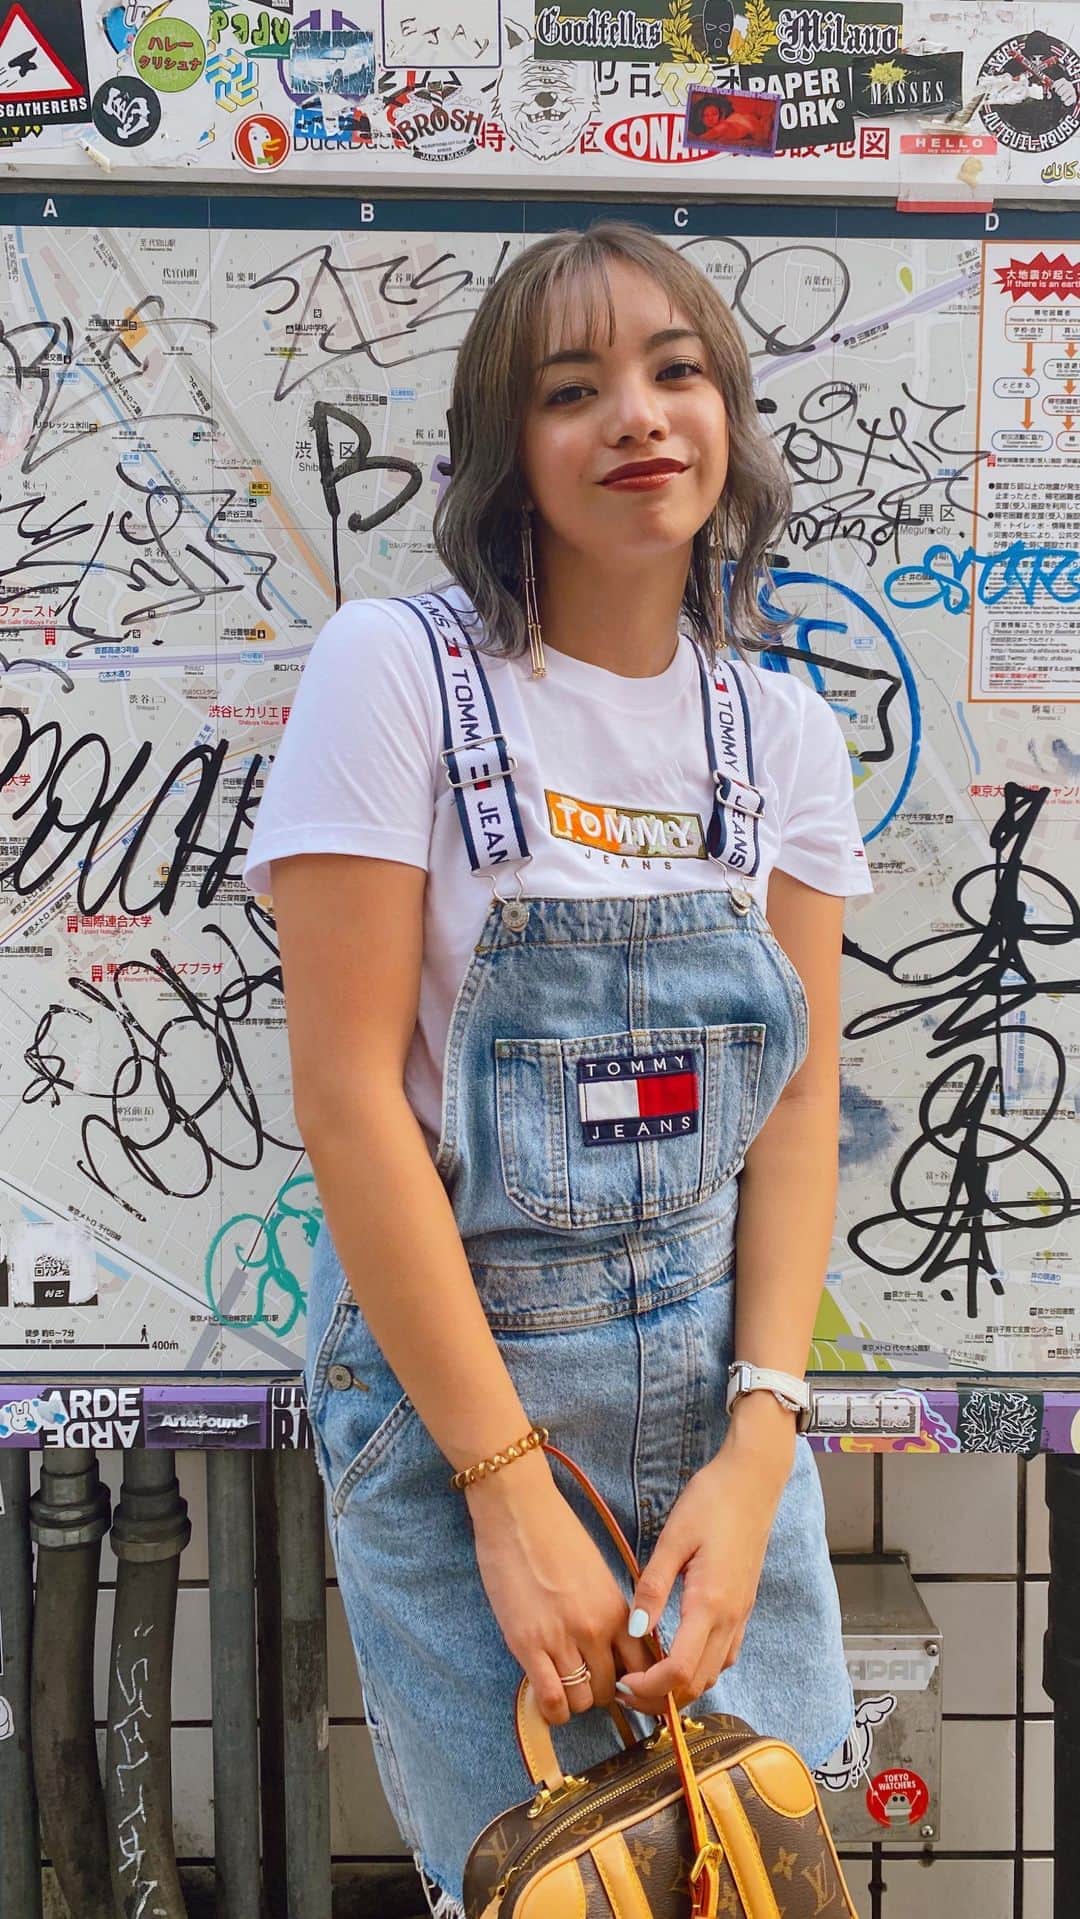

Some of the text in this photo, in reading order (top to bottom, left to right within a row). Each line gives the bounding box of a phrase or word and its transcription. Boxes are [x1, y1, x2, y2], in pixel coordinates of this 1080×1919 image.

[535, 6, 899, 64] Goodfellas Milano
[749, 68, 840, 99] PAPER
[871, 80, 944, 105] MASSES
[396, 104, 485, 144] BROSH
[915, 137, 983, 149] HELLO
[42, 198, 58, 218] A
[361, 203, 375, 223] B
[674, 207, 689, 228] C
[985, 213, 999, 231] D
[1015, 280, 1037, 288] there
[1039, 280, 1046, 288] is
[295, 441, 356, 460] 渋区
[208, 705, 279, 719] 渋谷ヒカリエ
[452, 668, 486, 753] TOMMY
[716, 699, 741, 773] TOMMY
[476, 801, 511, 866] JEAN
[556, 801, 692, 849] TOMMY
[727, 794, 748, 870] JEANS
[584, 850, 672, 871] JEANS
[81, 914, 153, 928] 国際連合大学
[586, 1055, 685, 1077] TOMMY
[592, 1116, 691, 1140] JEANS
[152, 1340, 179, 1350] 400m
[878, 1779, 917, 1791] WATCHERS
[884, 1772, 910, 1783] TOKYO
